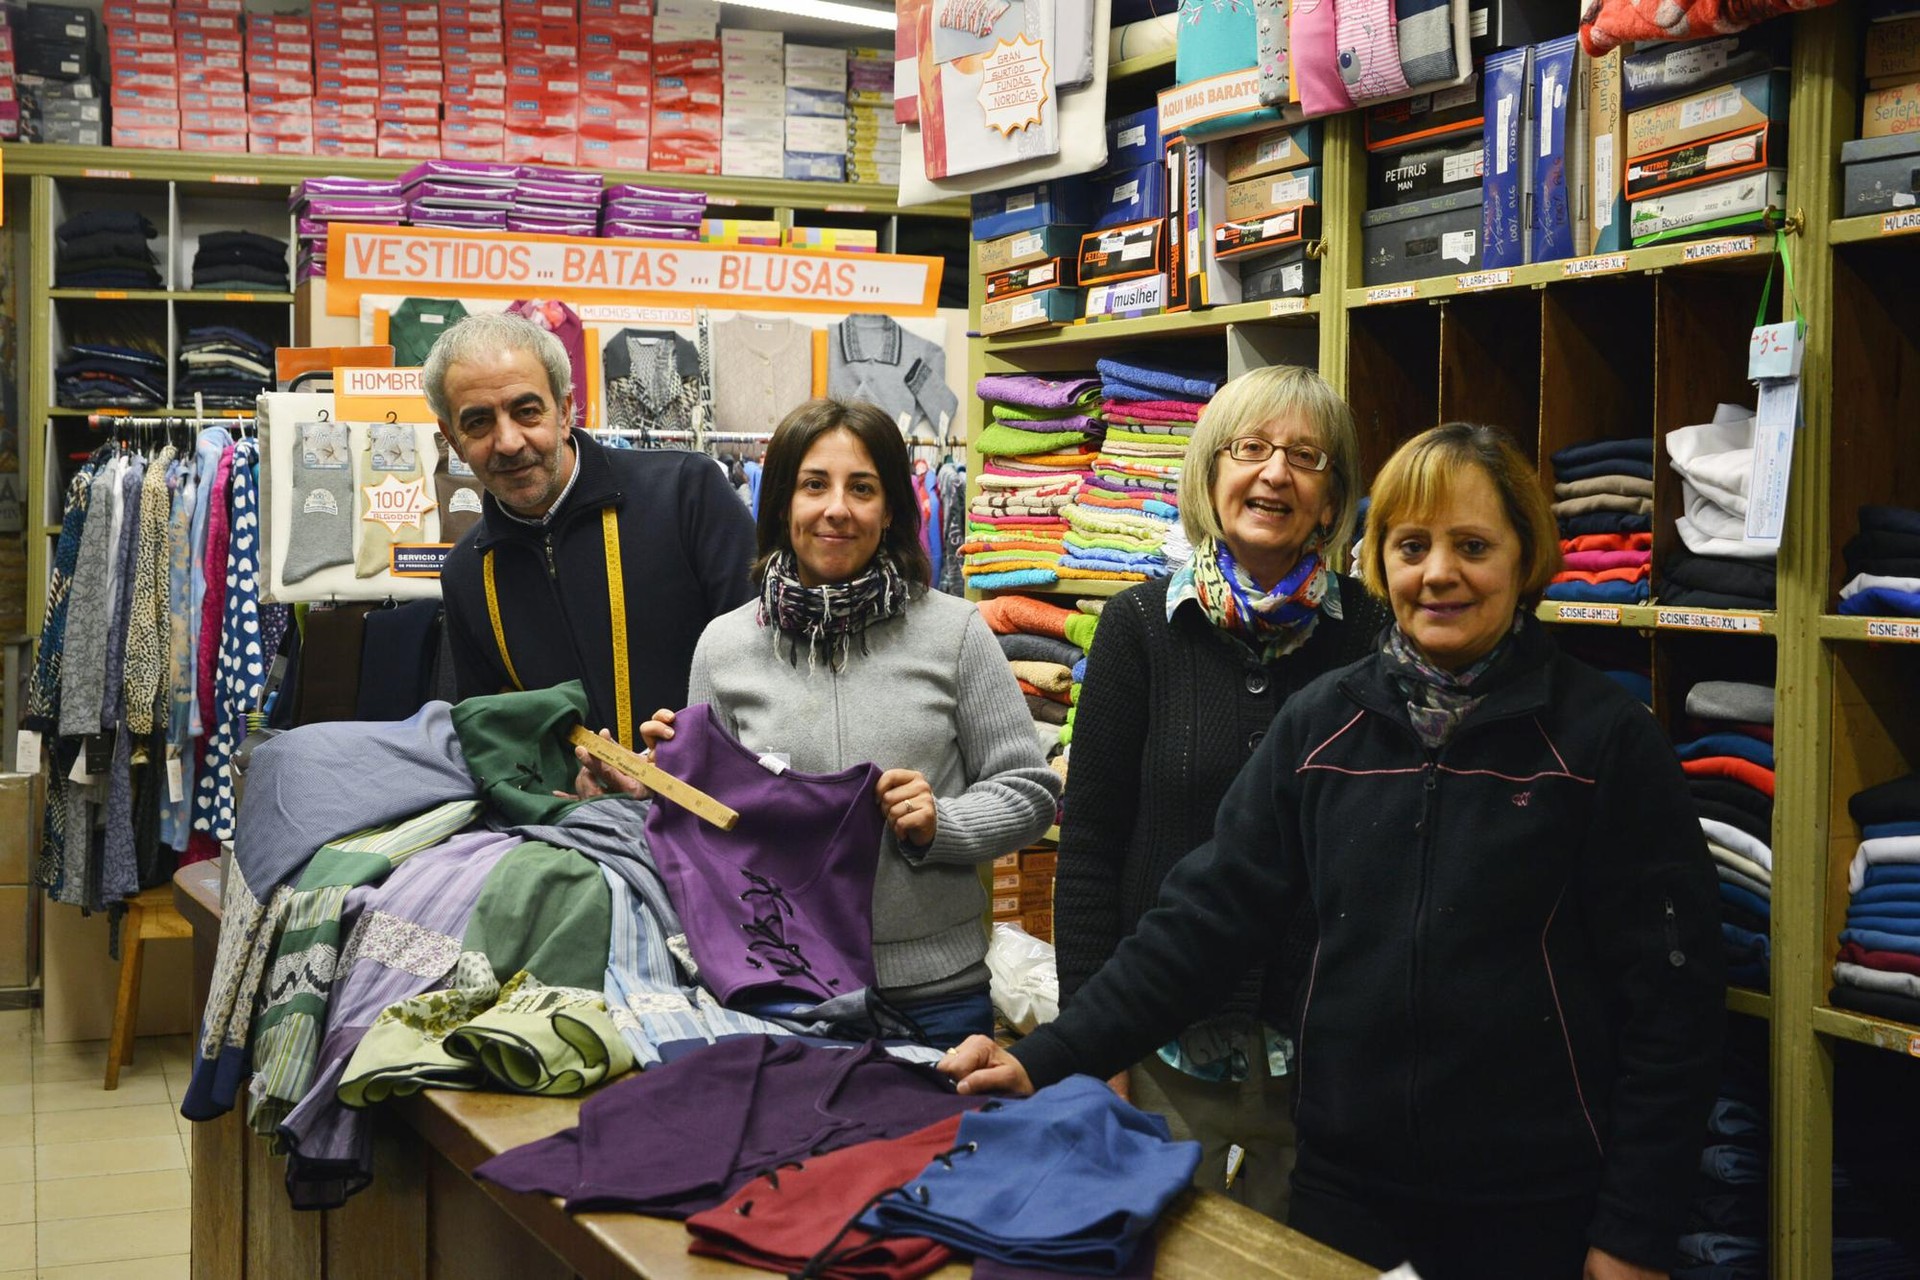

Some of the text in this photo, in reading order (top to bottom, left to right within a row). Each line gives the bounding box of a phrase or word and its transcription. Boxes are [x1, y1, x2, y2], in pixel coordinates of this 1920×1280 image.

[997, 50, 1021, 65] GRAN
[997, 75, 1031, 91] FUNDAS
[1163, 101, 1184, 119] AQUI
[1186, 91, 1205, 111] MAS
[1385, 163, 1427, 183] PETTRUS
[1397, 180, 1413, 191] MAN
[374, 486, 420, 513] 100%
[1870, 622, 1898, 637] CISNE
